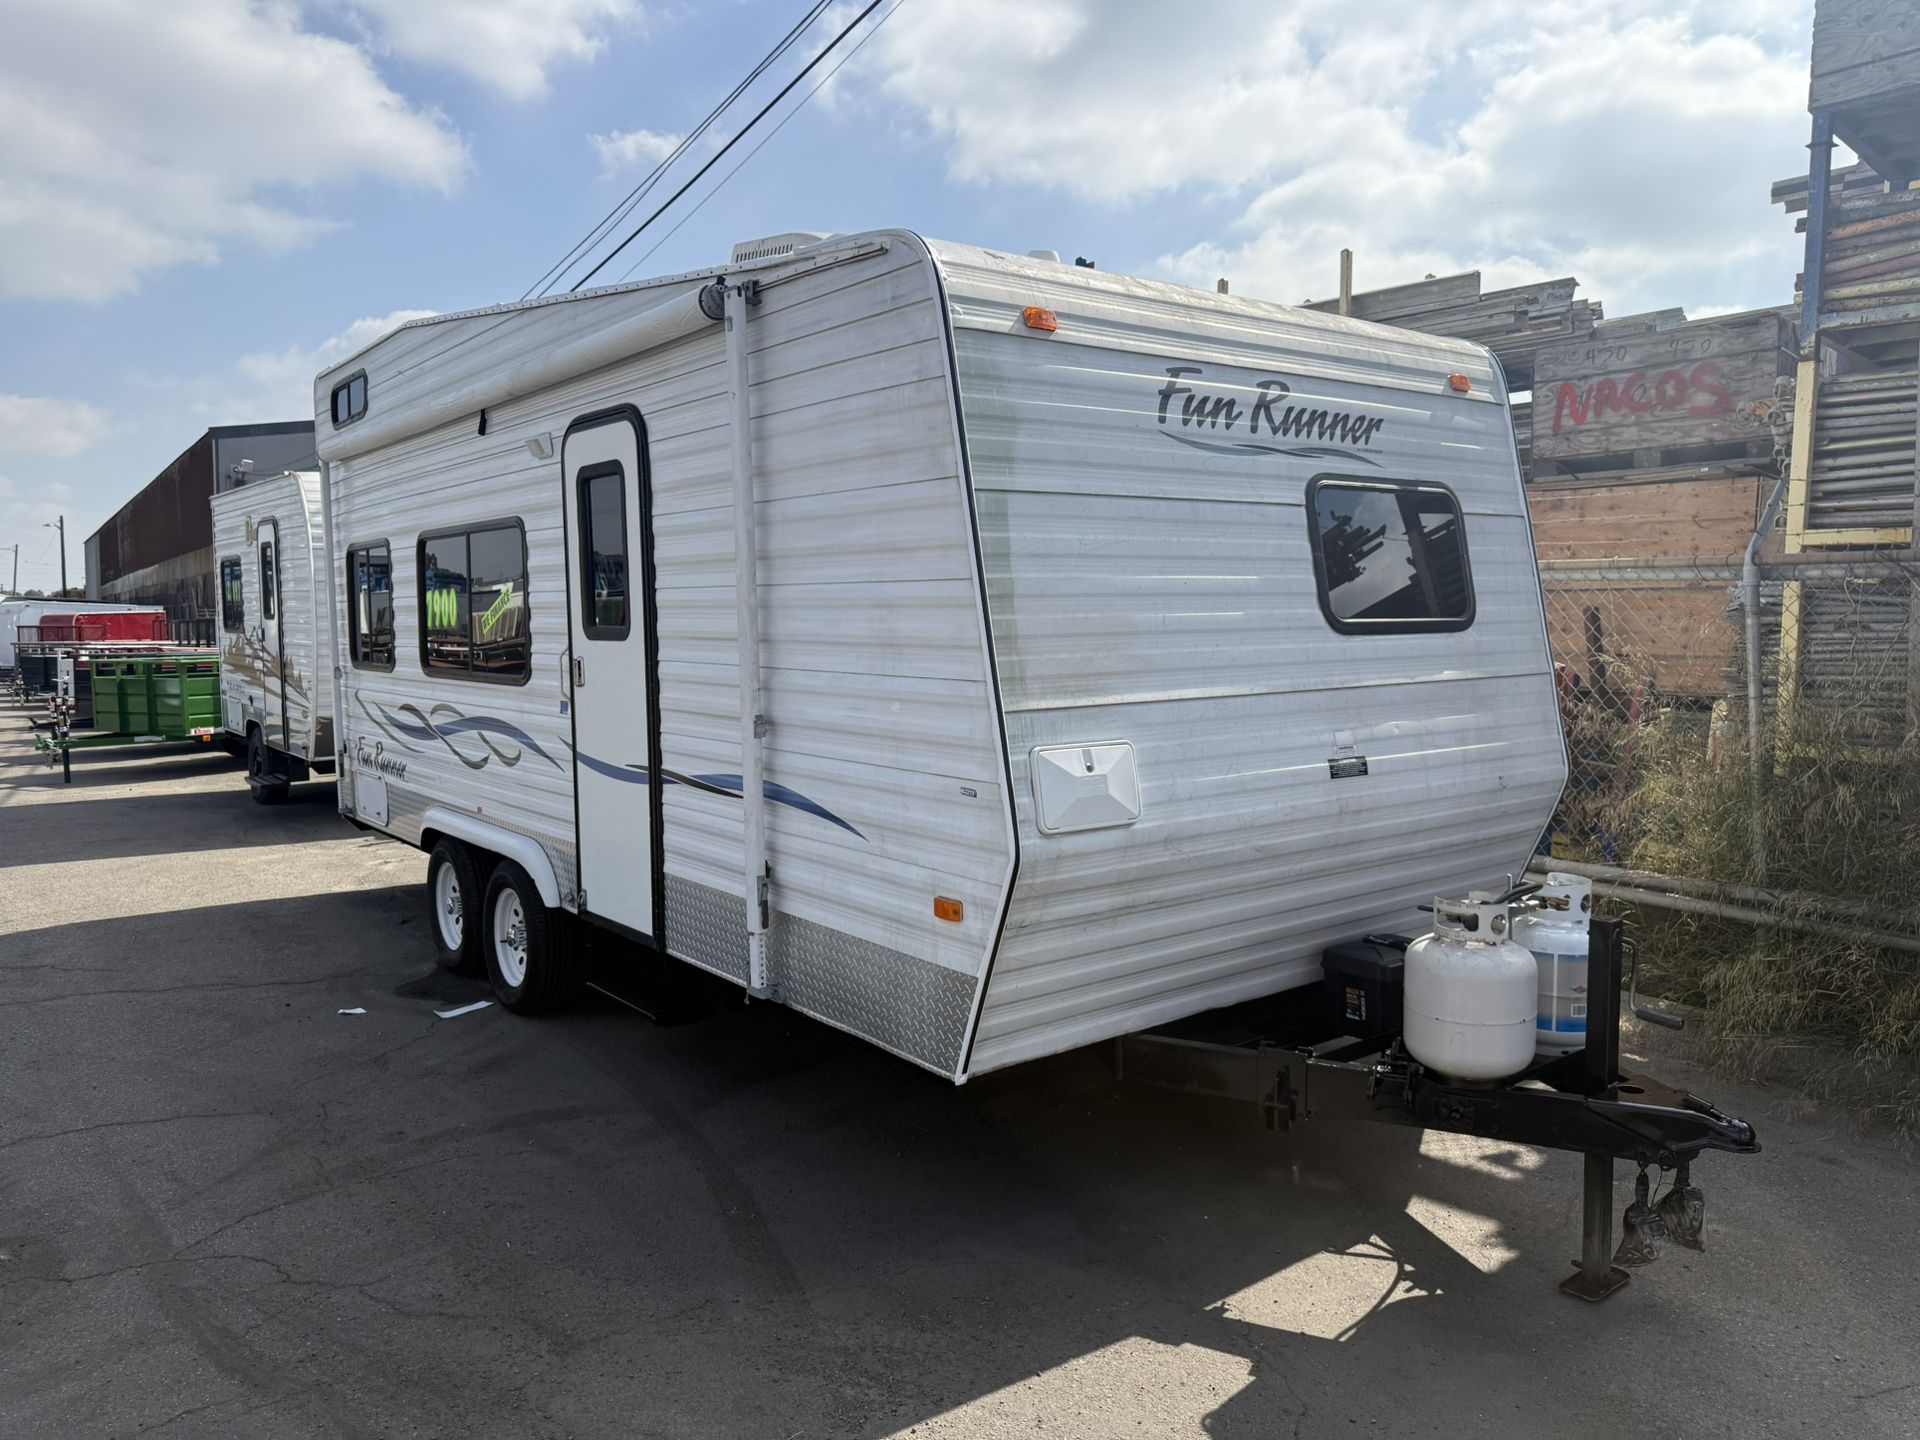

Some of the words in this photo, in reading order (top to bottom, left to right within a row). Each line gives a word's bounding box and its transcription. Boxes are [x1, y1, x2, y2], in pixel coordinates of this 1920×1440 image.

[1158, 367, 1243, 430] Fun
[1250, 380, 1384, 446] Runner
[357, 736, 373, 769] Fun
[374, 741, 408, 780] Runner
